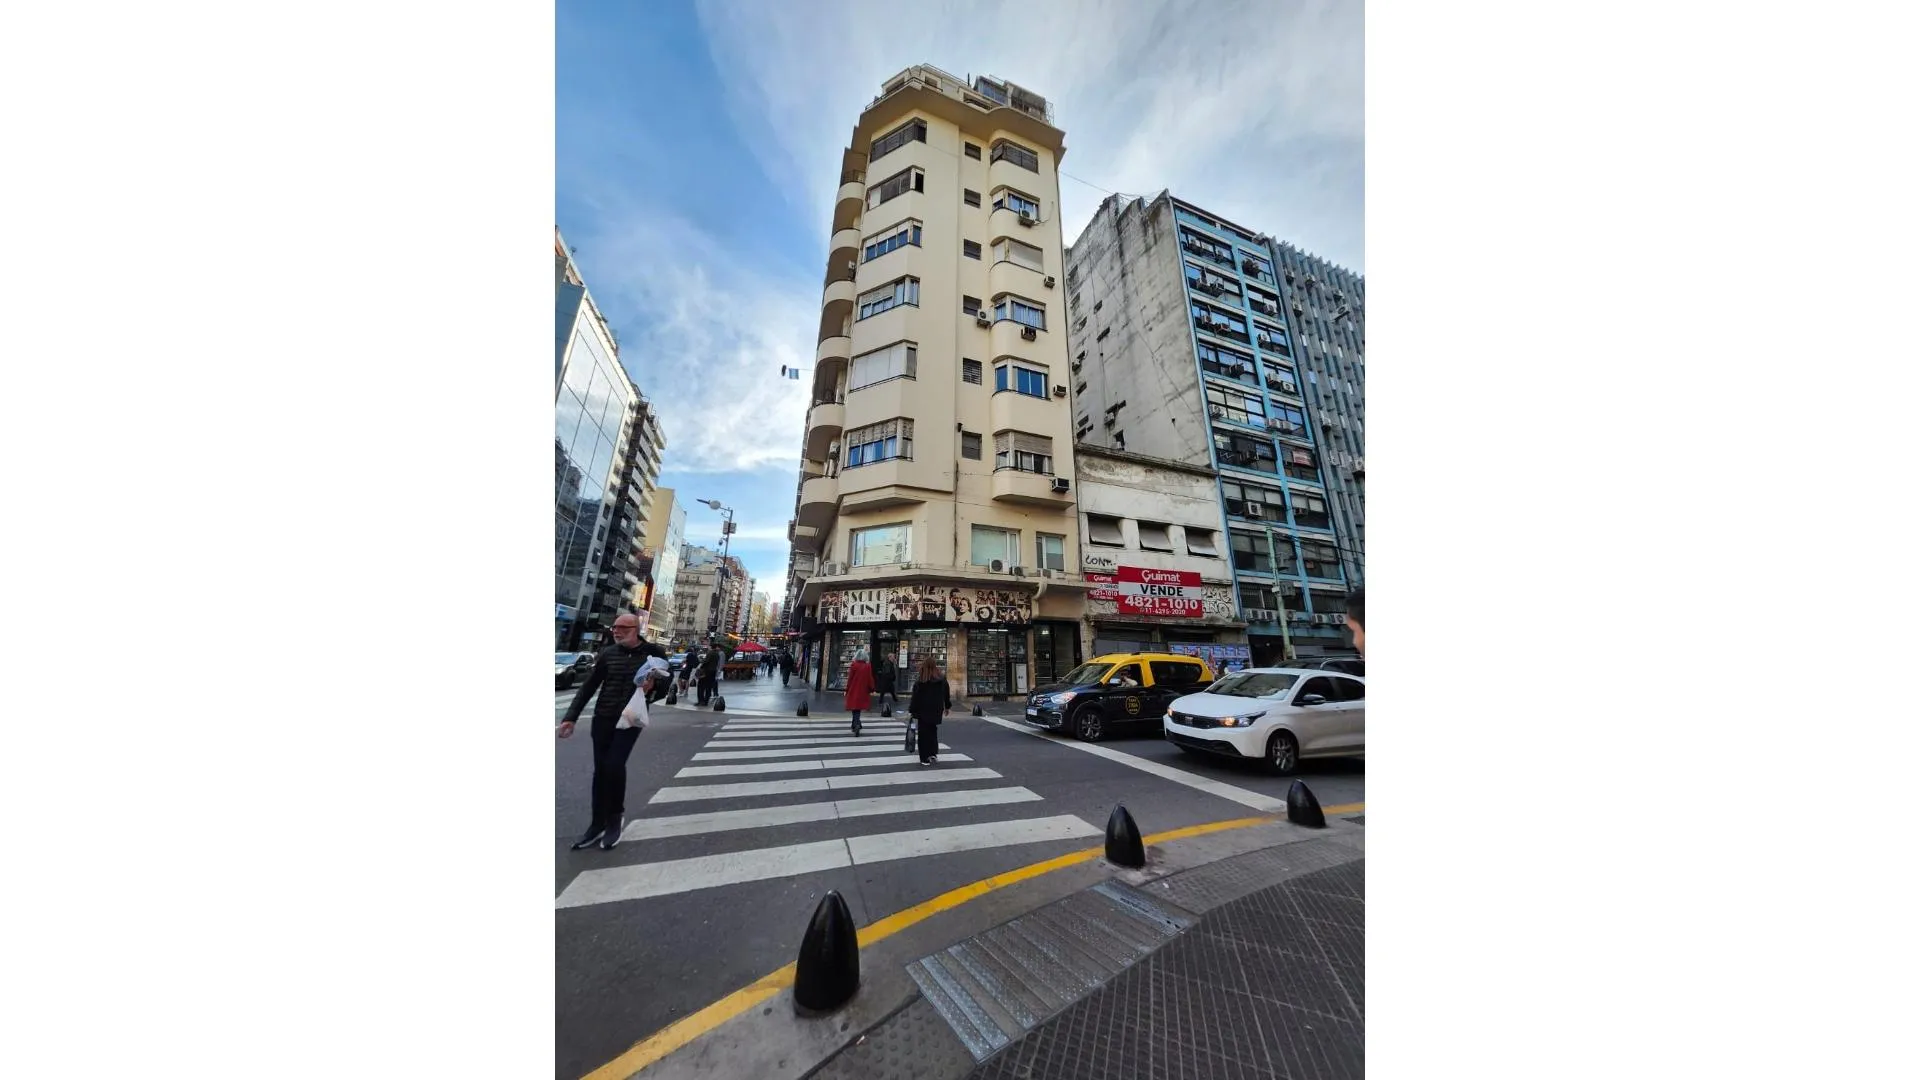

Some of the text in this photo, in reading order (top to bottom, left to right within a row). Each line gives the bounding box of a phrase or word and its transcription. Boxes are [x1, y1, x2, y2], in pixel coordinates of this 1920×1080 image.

[1141, 569, 1180, 582] Guimat
[1140, 584, 1183, 596] VENDE
[1125, 595, 1198, 609] 4821-1010
[850, 603, 884, 616] CINE
